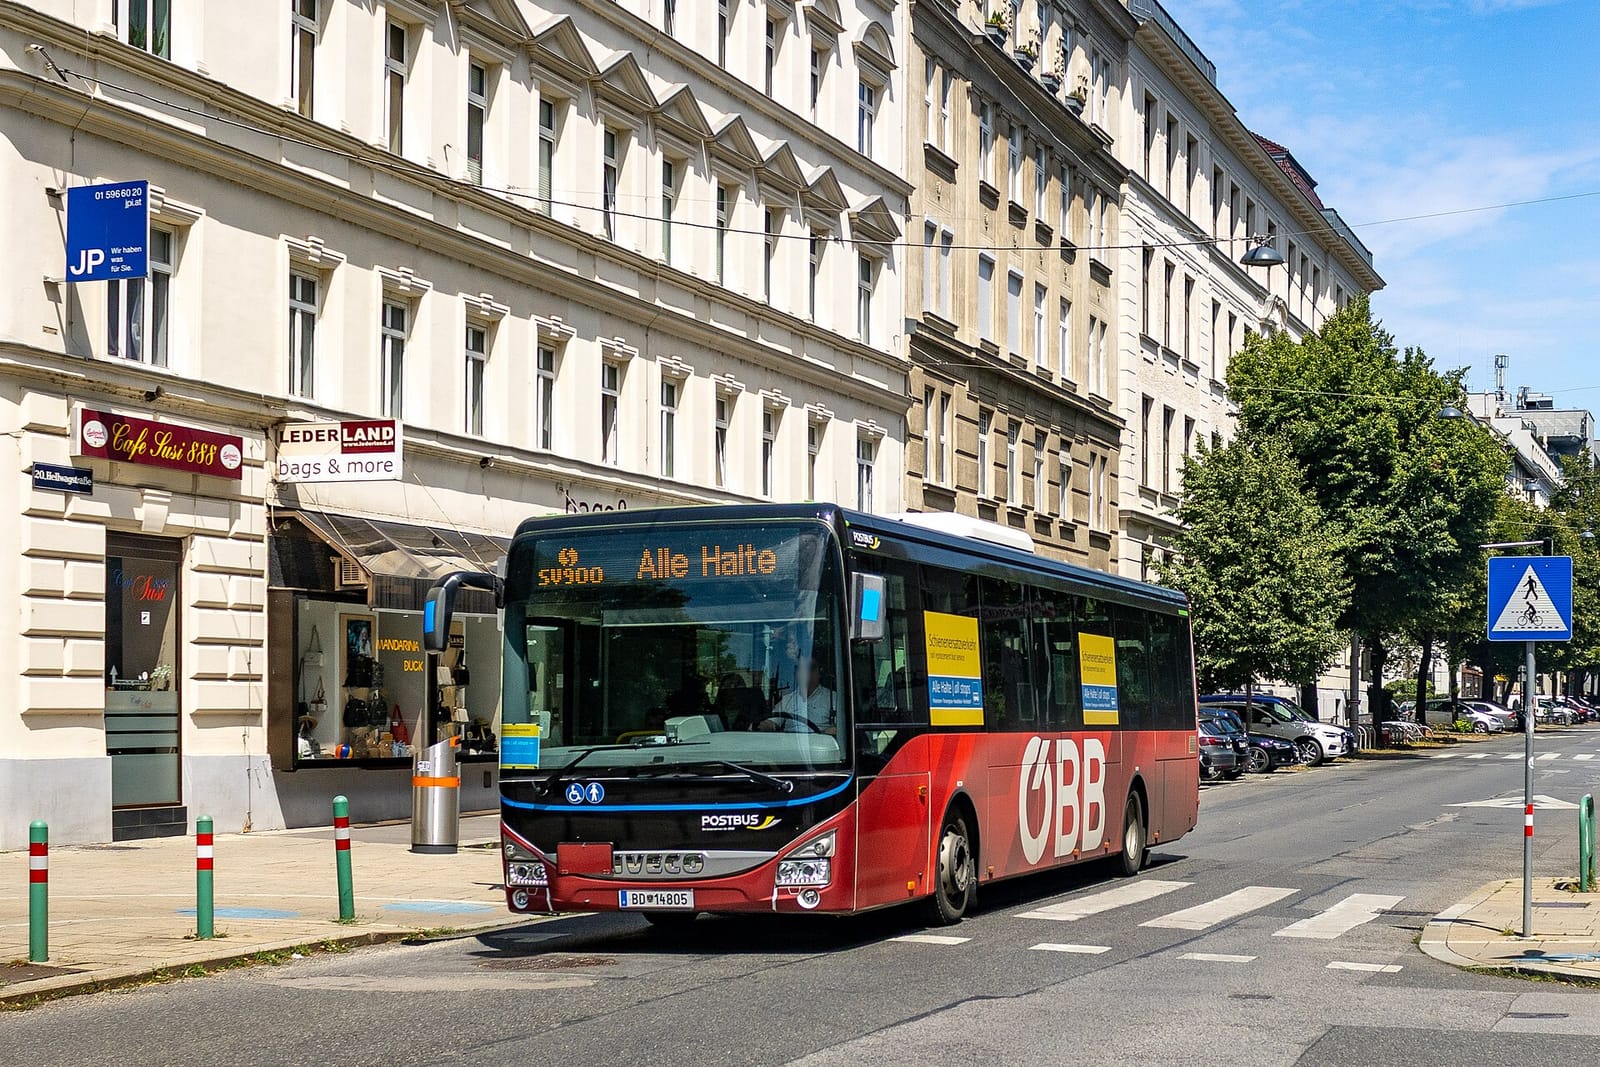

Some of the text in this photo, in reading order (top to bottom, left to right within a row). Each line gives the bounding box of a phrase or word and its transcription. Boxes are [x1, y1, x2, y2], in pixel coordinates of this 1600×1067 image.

[95, 191, 104, 200] 01
[132, 187, 142, 197] 20
[70, 249, 105, 275] JP
[280, 427, 394, 443] LEDER LAND
[150, 431, 185, 461] Susi
[186, 441, 217, 466] 888
[279, 458, 393, 479] bags & more
[636, 543, 777, 580] Alle Halte
[376, 639, 420, 652] MANDARINA
[403, 660, 425, 672] DUCK
[1019, 736, 1106, 865] ÖBB
[702, 814, 760, 827] POSTBUS
[614, 853, 705, 875] IVECO
[631, 893, 688, 906] BD 14805
